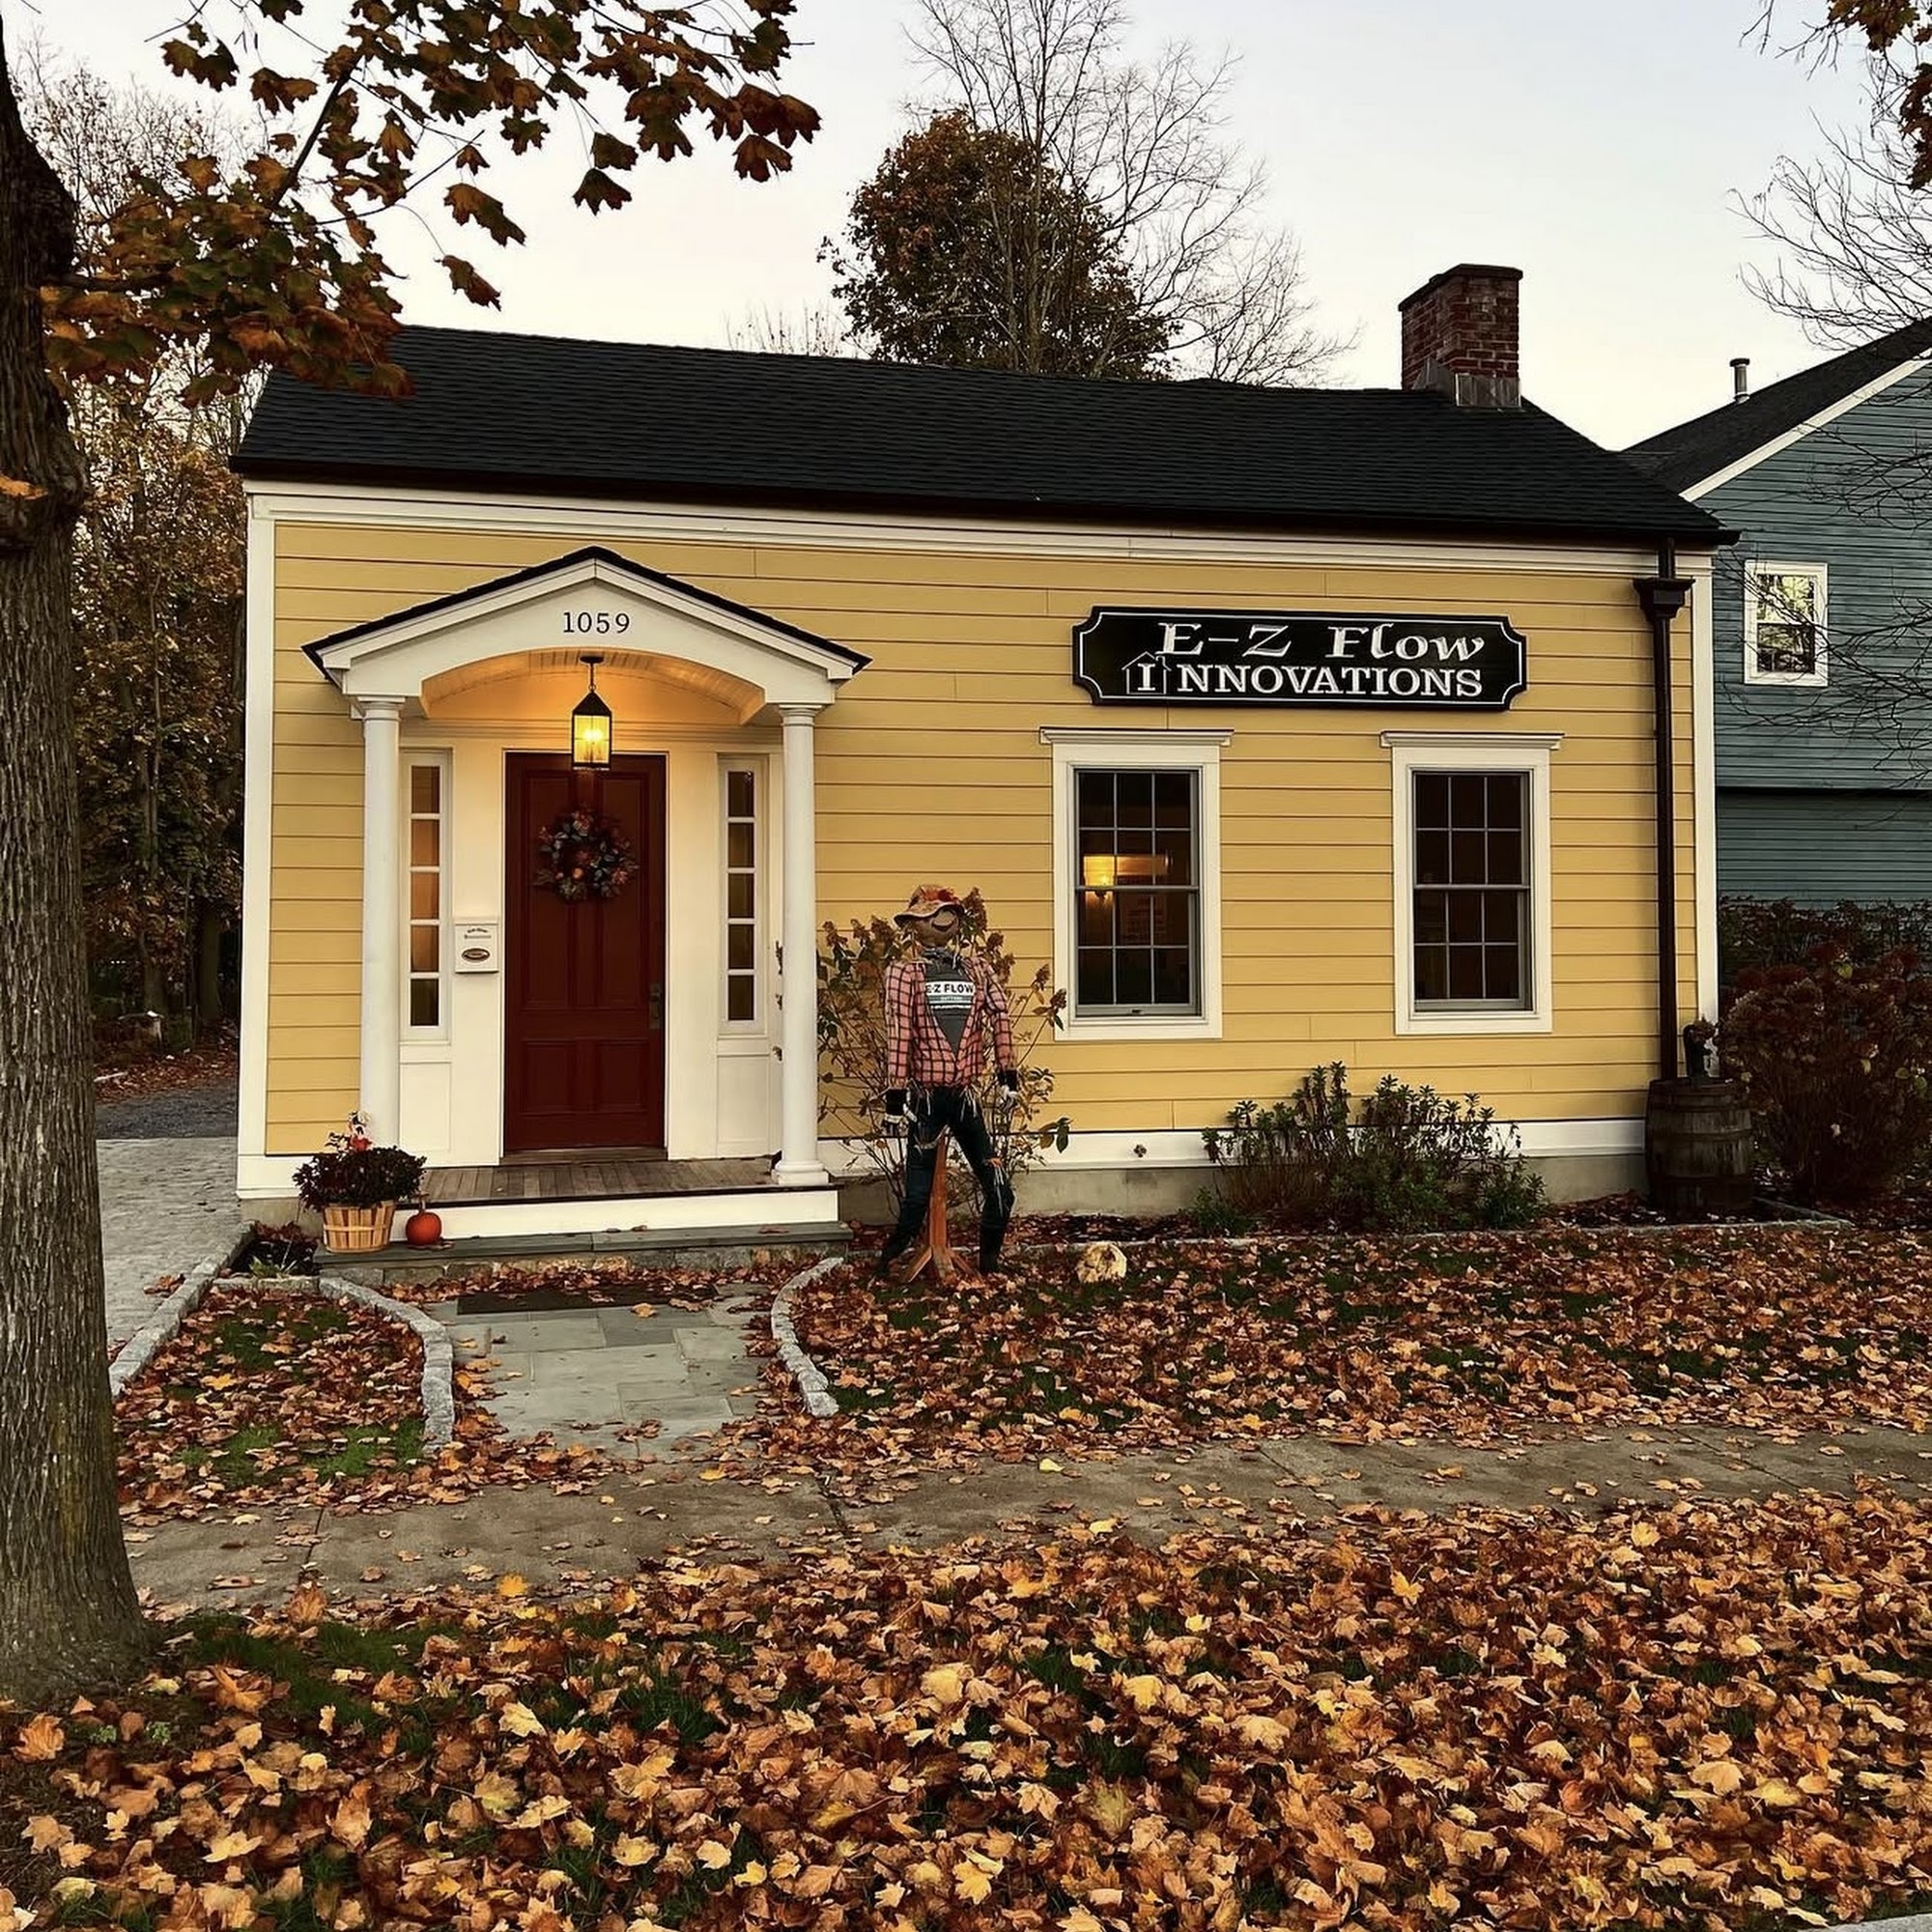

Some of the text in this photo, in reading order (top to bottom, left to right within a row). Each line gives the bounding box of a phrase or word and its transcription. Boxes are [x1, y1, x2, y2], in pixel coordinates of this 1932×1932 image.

[562, 611, 630, 634] 1059
[1156, 622, 1484, 662] E-Z Flow
[1136, 663, 1483, 697] INNOVATIONS
[944, 983, 974, 993] FLOW
